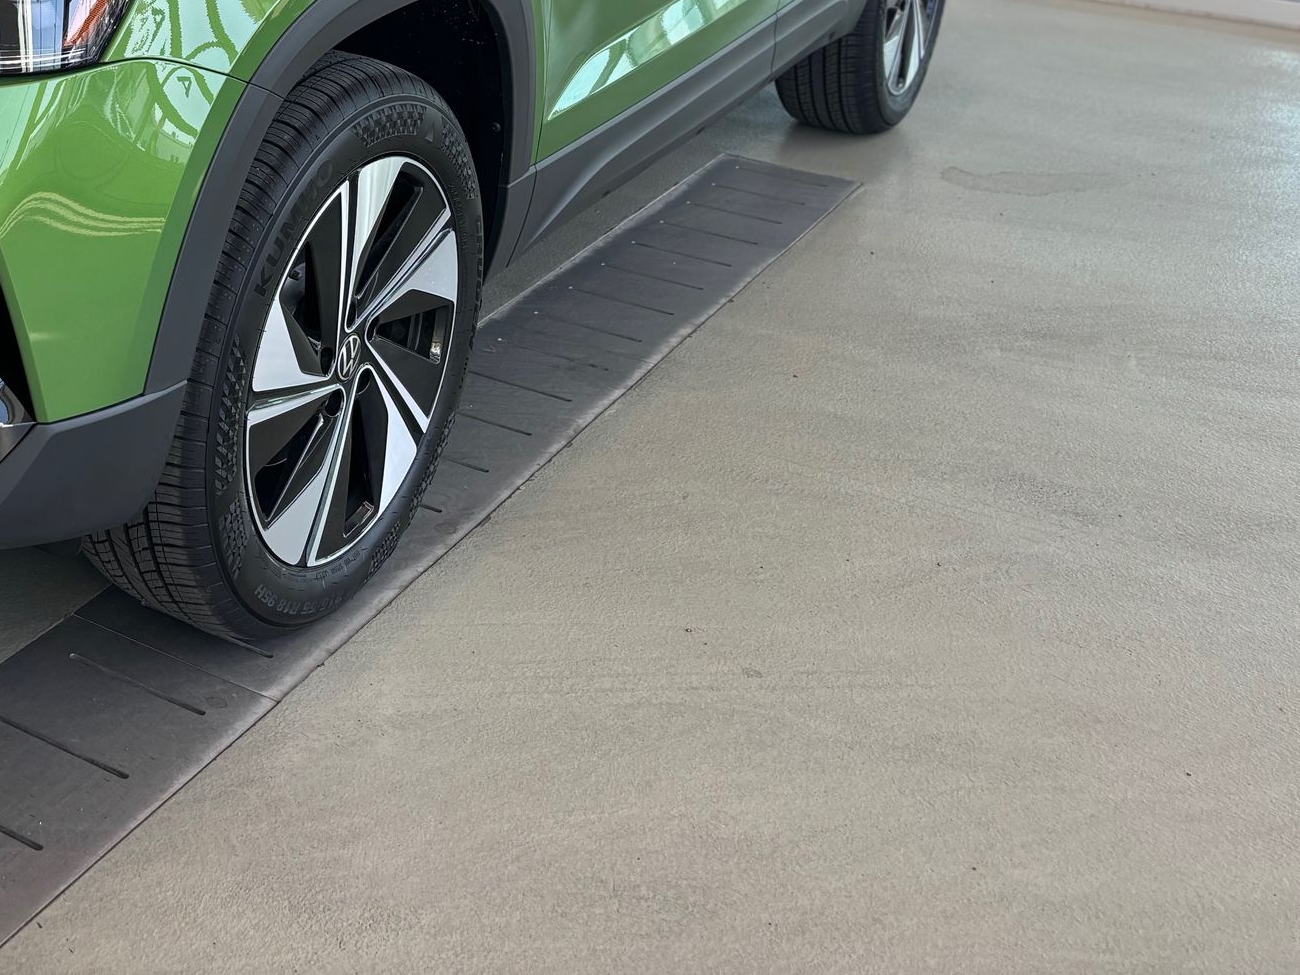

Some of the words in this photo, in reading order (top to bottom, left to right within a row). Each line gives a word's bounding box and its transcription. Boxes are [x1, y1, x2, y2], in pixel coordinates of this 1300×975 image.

[254, 160, 333, 297] KUMHO
[254, 584, 277, 607] 95H
[277, 599, 300, 615] R18
